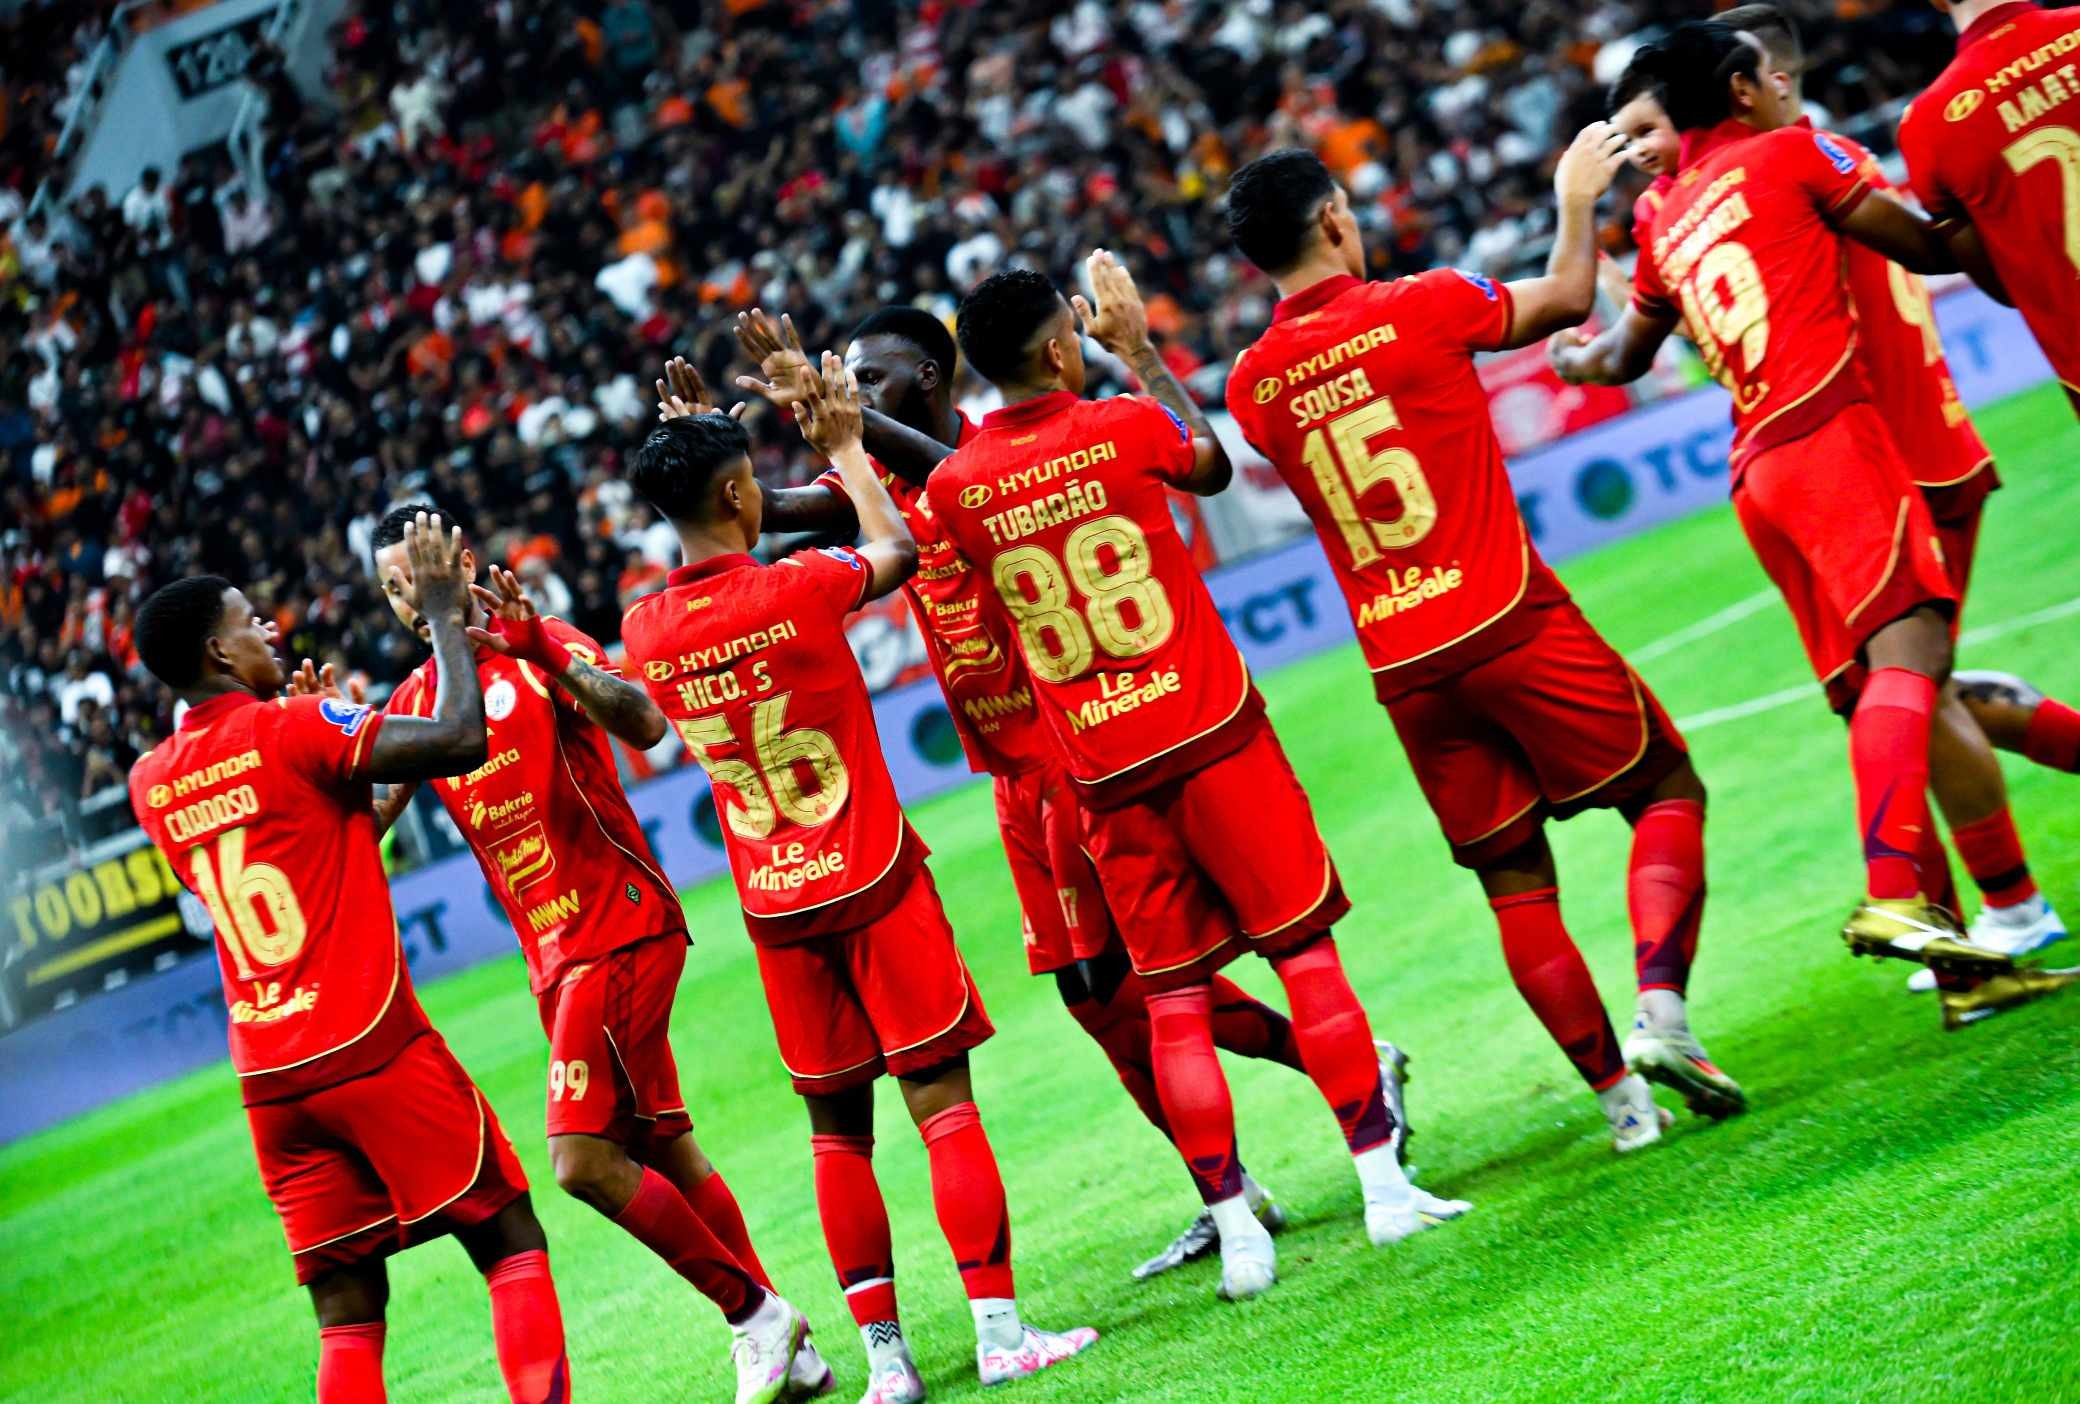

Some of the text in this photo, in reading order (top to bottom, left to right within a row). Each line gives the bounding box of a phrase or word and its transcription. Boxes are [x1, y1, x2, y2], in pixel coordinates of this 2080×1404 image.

[1286, 323, 1398, 386] HYUNDAI
[1289, 368, 1374, 429] SOUSA
[998, 441, 1118, 496] HYUNDAI
[1302, 395, 1438, 571] 15
[982, 478, 1107, 545] TUBARÃO
[991, 514, 1175, 684] 88
[1386, 566, 1422, 595] Le
[679, 619, 798, 673] HYUNDAI
[752, 661, 773, 692] S
[1065, 671, 1181, 735] Minerale
[1097, 672, 1135, 699] Le
[172, 749, 263, 797] HYUNDAI
[674, 690, 849, 841] 56
[164, 784, 260, 843] CARDOSO
[487, 790, 533, 822] Bakrie
[771, 842, 805, 867] Le
[186, 826, 308, 981] 16
[550, 1059, 589, 1103] 99
